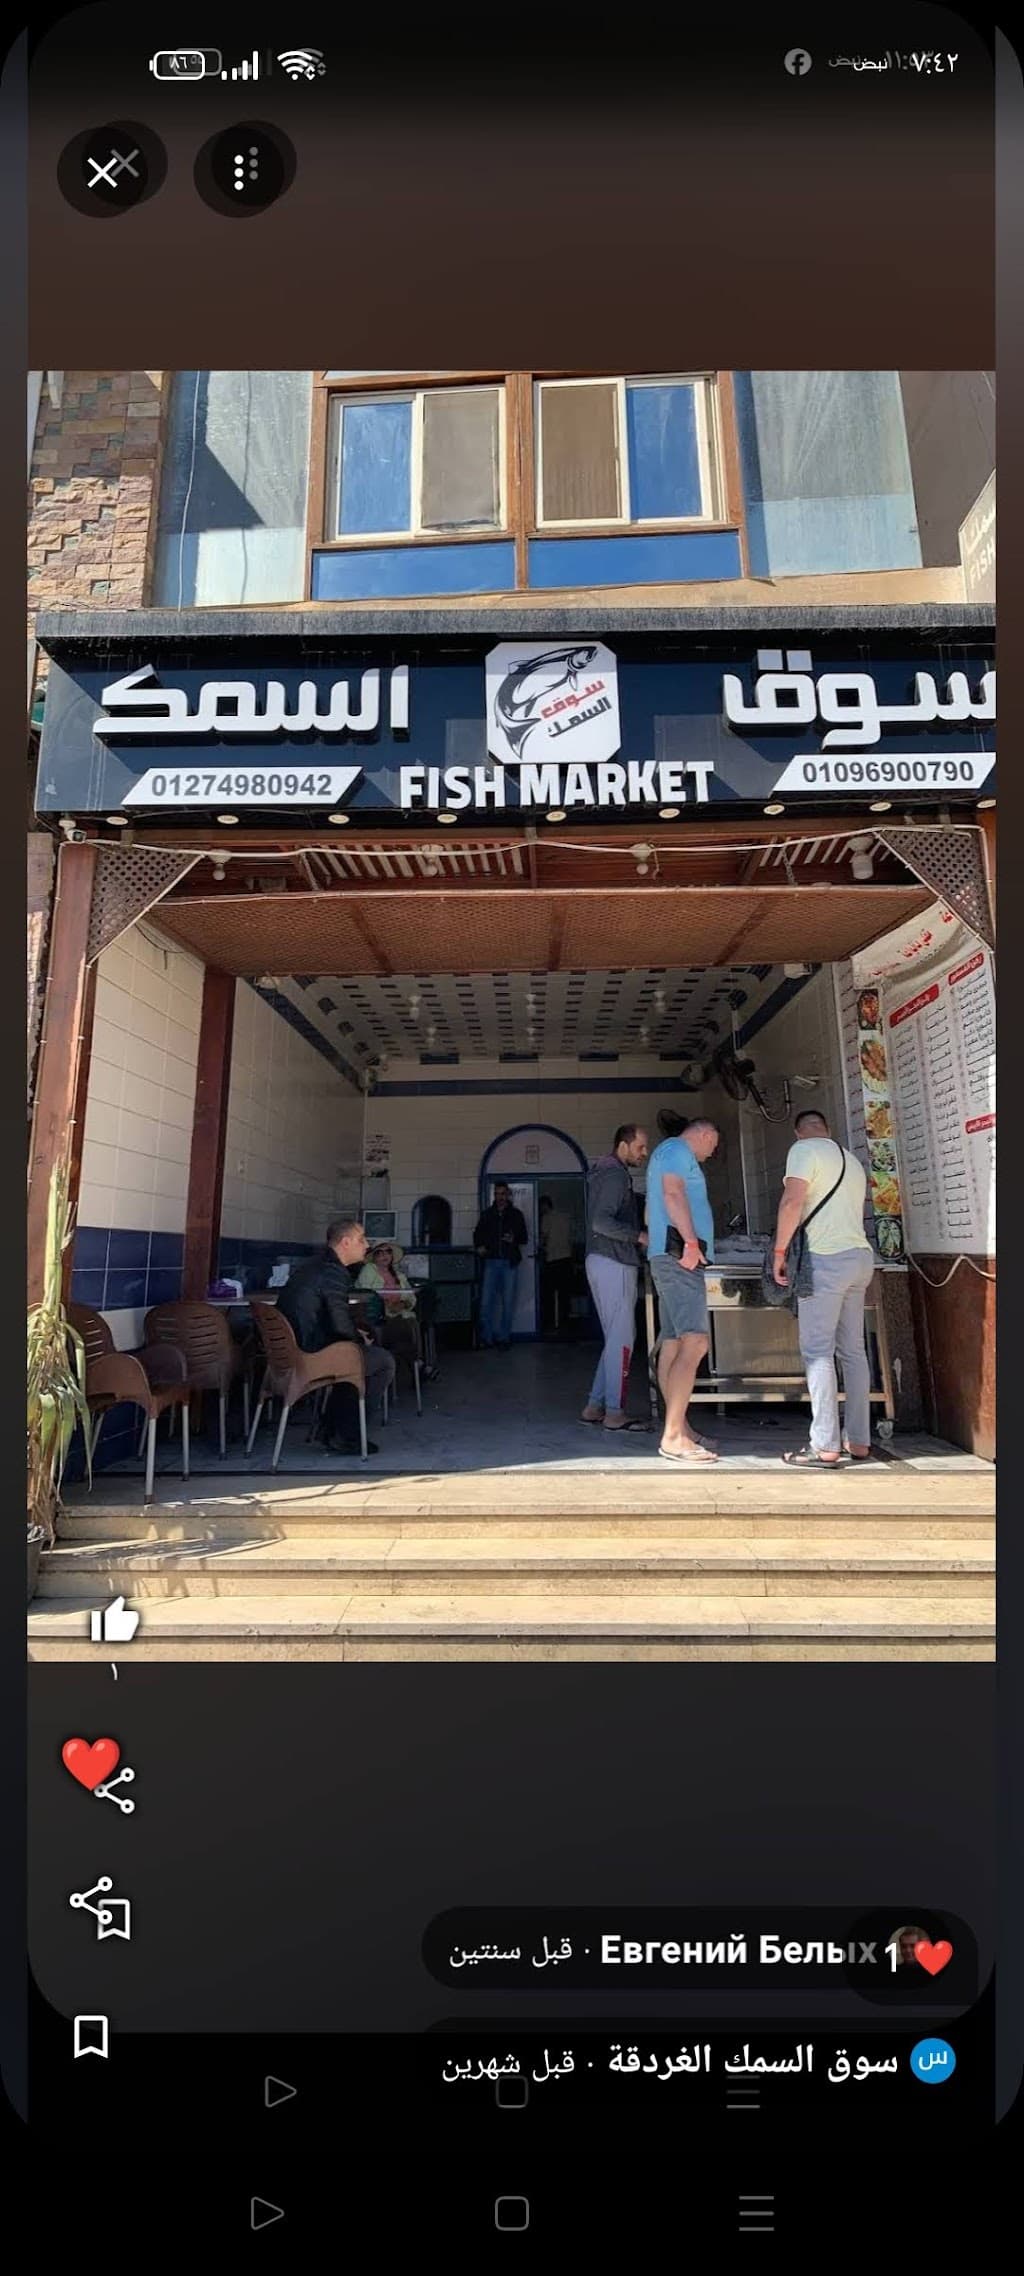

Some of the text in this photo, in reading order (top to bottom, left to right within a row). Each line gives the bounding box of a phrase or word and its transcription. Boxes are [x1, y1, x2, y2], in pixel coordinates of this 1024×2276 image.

[92, 649, 996, 750] سوق السمك
[547, 696, 612, 738] السمك
[151, 773, 333, 797] 01274980942
[400, 760, 714, 810] FISH MARKET
[802, 759, 975, 784] 01096900790
